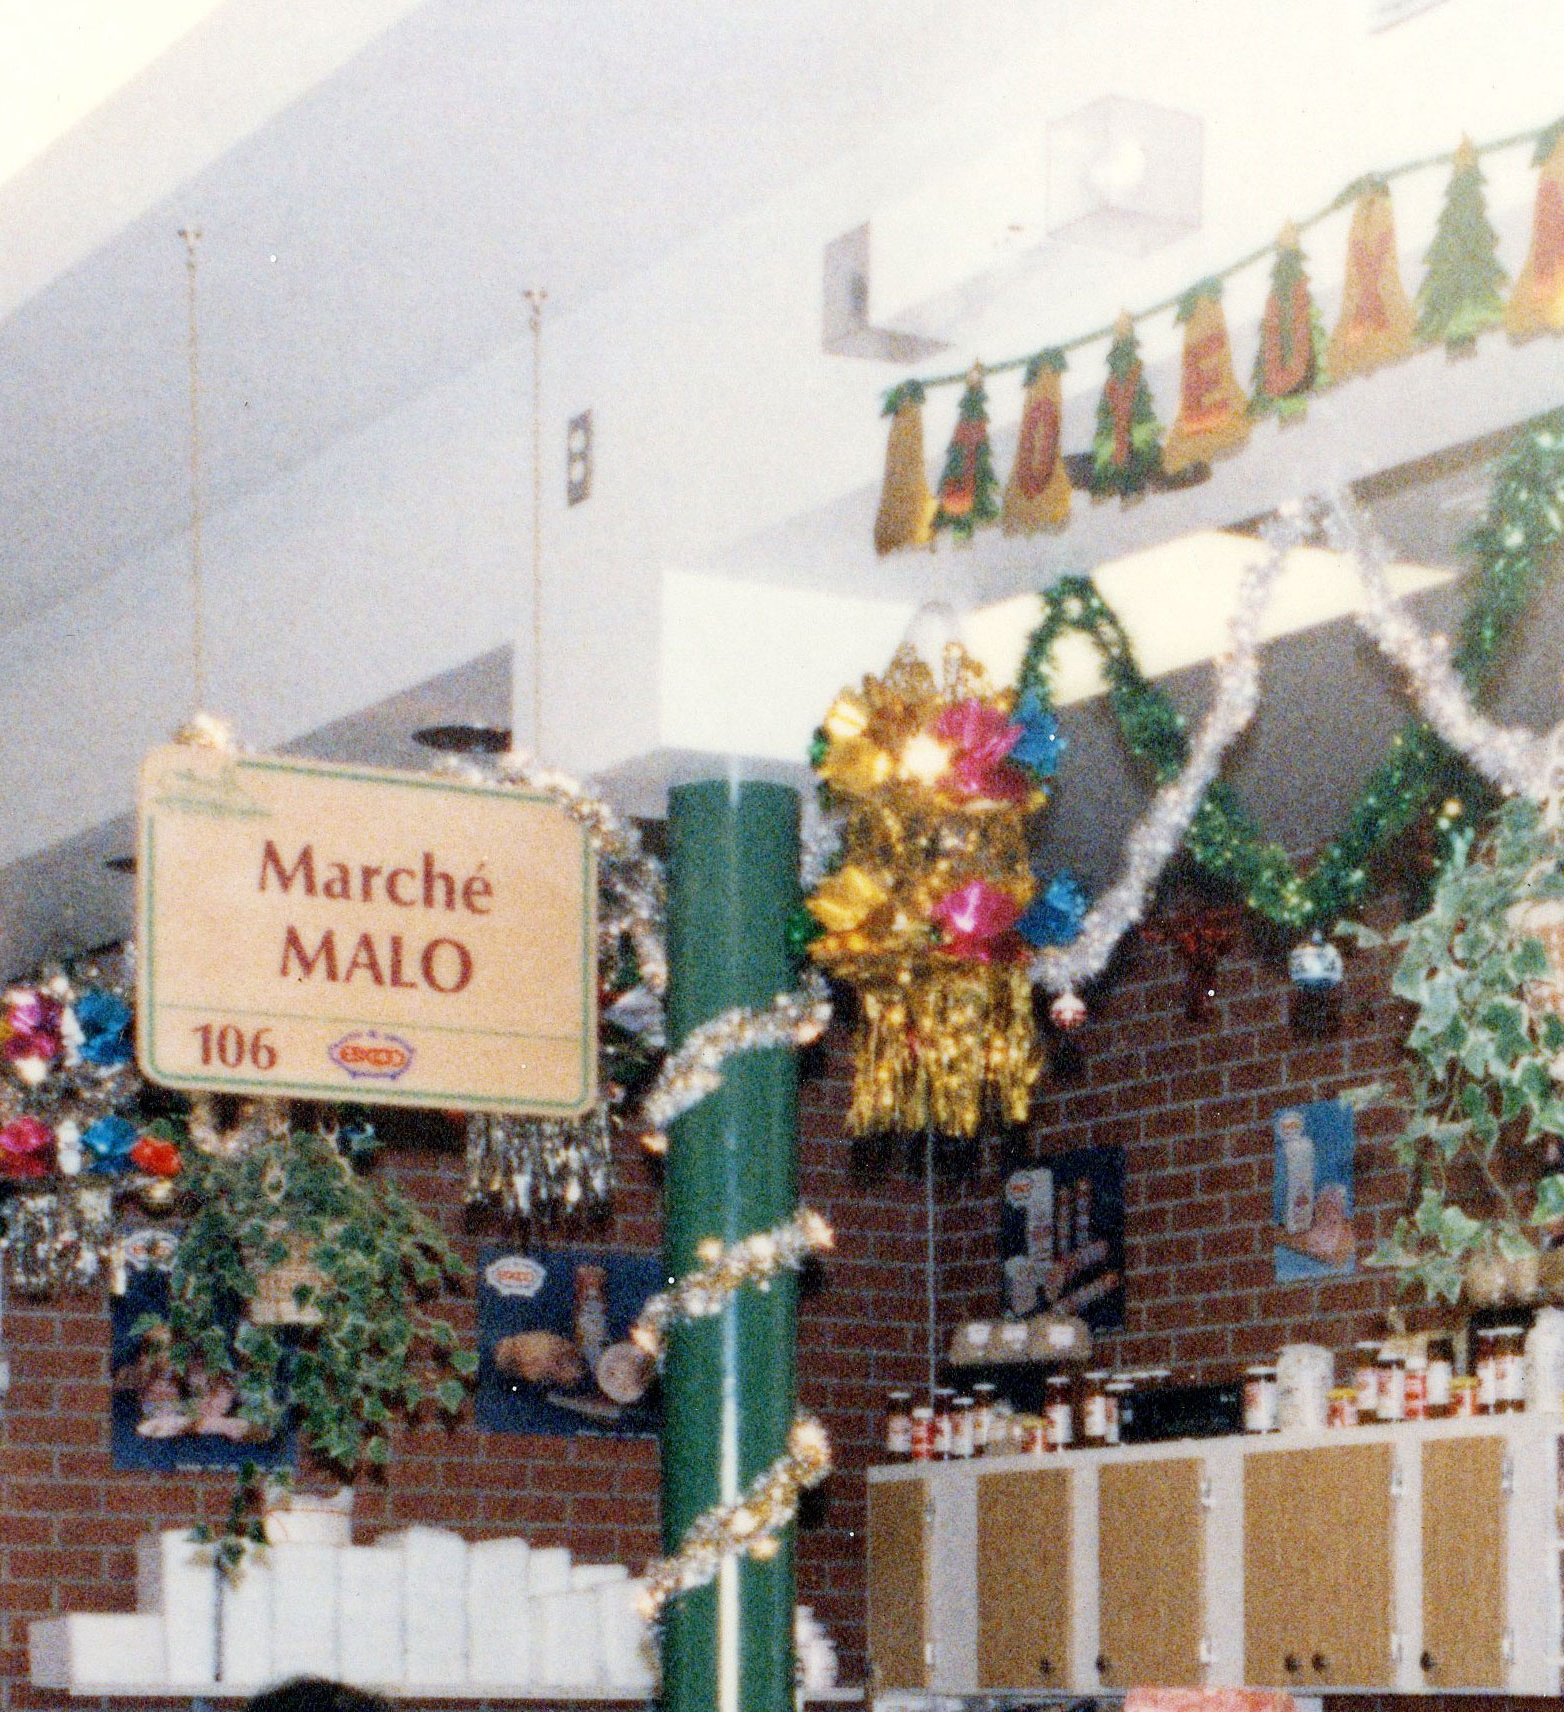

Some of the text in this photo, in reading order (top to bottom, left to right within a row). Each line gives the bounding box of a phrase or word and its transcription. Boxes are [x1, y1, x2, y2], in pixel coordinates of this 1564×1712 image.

[258, 840, 494, 915] Marché
[280, 925, 474, 994] MALO
[192, 1023, 279, 1071] 106
